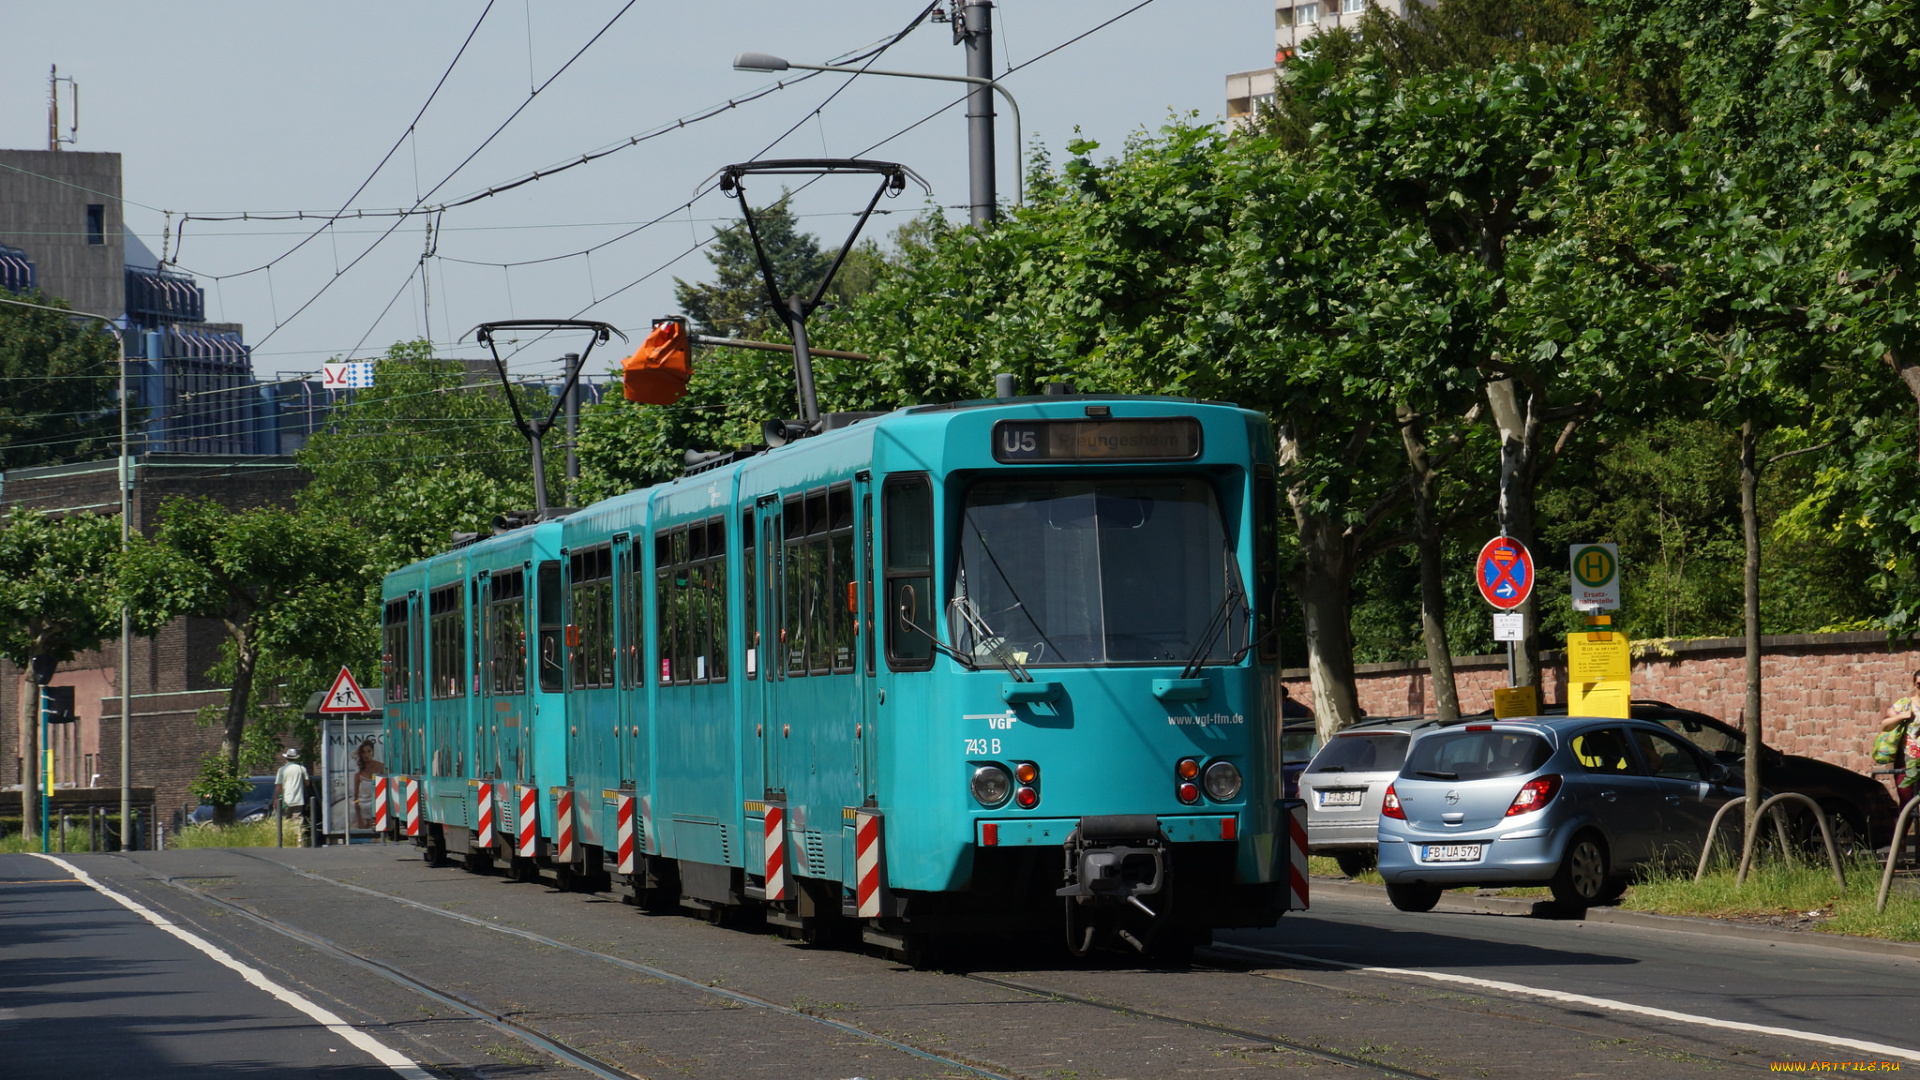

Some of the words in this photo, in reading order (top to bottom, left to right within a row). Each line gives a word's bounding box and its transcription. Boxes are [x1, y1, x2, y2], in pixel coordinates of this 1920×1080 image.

[1004, 431, 1036, 452] U5
[1586, 555, 1603, 578] H
[988, 710, 1017, 730] VGF
[1167, 712, 1244, 727] www.vgf-ffm.de
[964, 738, 988, 755] 743
[991, 738, 1002, 755] B
[1428, 846, 1440, 858] FB
[1446, 845, 1459, 858] UA
[1460, 845, 1479, 858] 579
